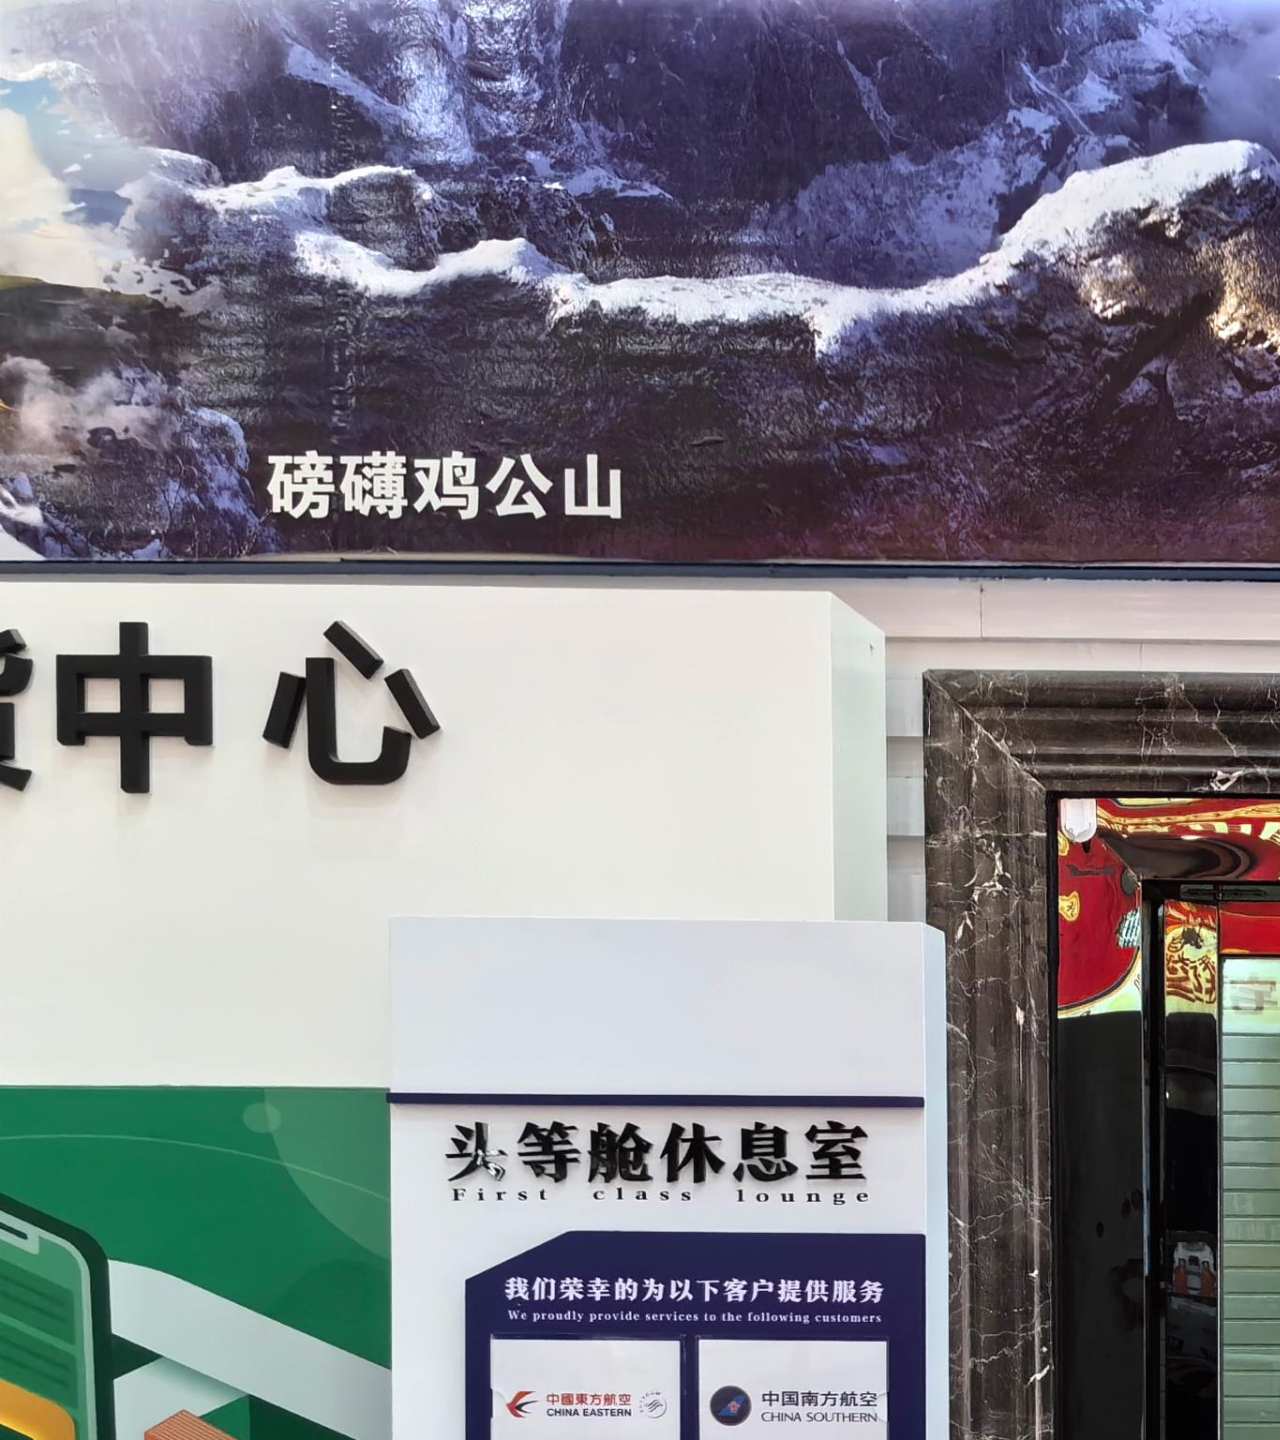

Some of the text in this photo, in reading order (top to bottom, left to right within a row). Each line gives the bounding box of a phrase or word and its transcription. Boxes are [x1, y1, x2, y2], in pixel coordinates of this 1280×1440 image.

[267, 451, 624, 520] 磅礴鸡公山
[0, 620, 441, 794] 中心
[445, 1121, 869, 1184] 头等舱休息室
[453, 1187, 871, 1206] First class lounge
[504, 1277, 884, 1303] 我们荣幸的为以下客户提供服务
[508, 1309, 883, 1325] We proudly provide services to the following customers
[546, 1392, 632, 1406] 中國東方航空
[761, 1390, 878, 1408] 中国南方航空
[546, 1408, 632, 1417] CHINA EASTERN
[761, 1411, 878, 1422] CHINA SOUTHERN
